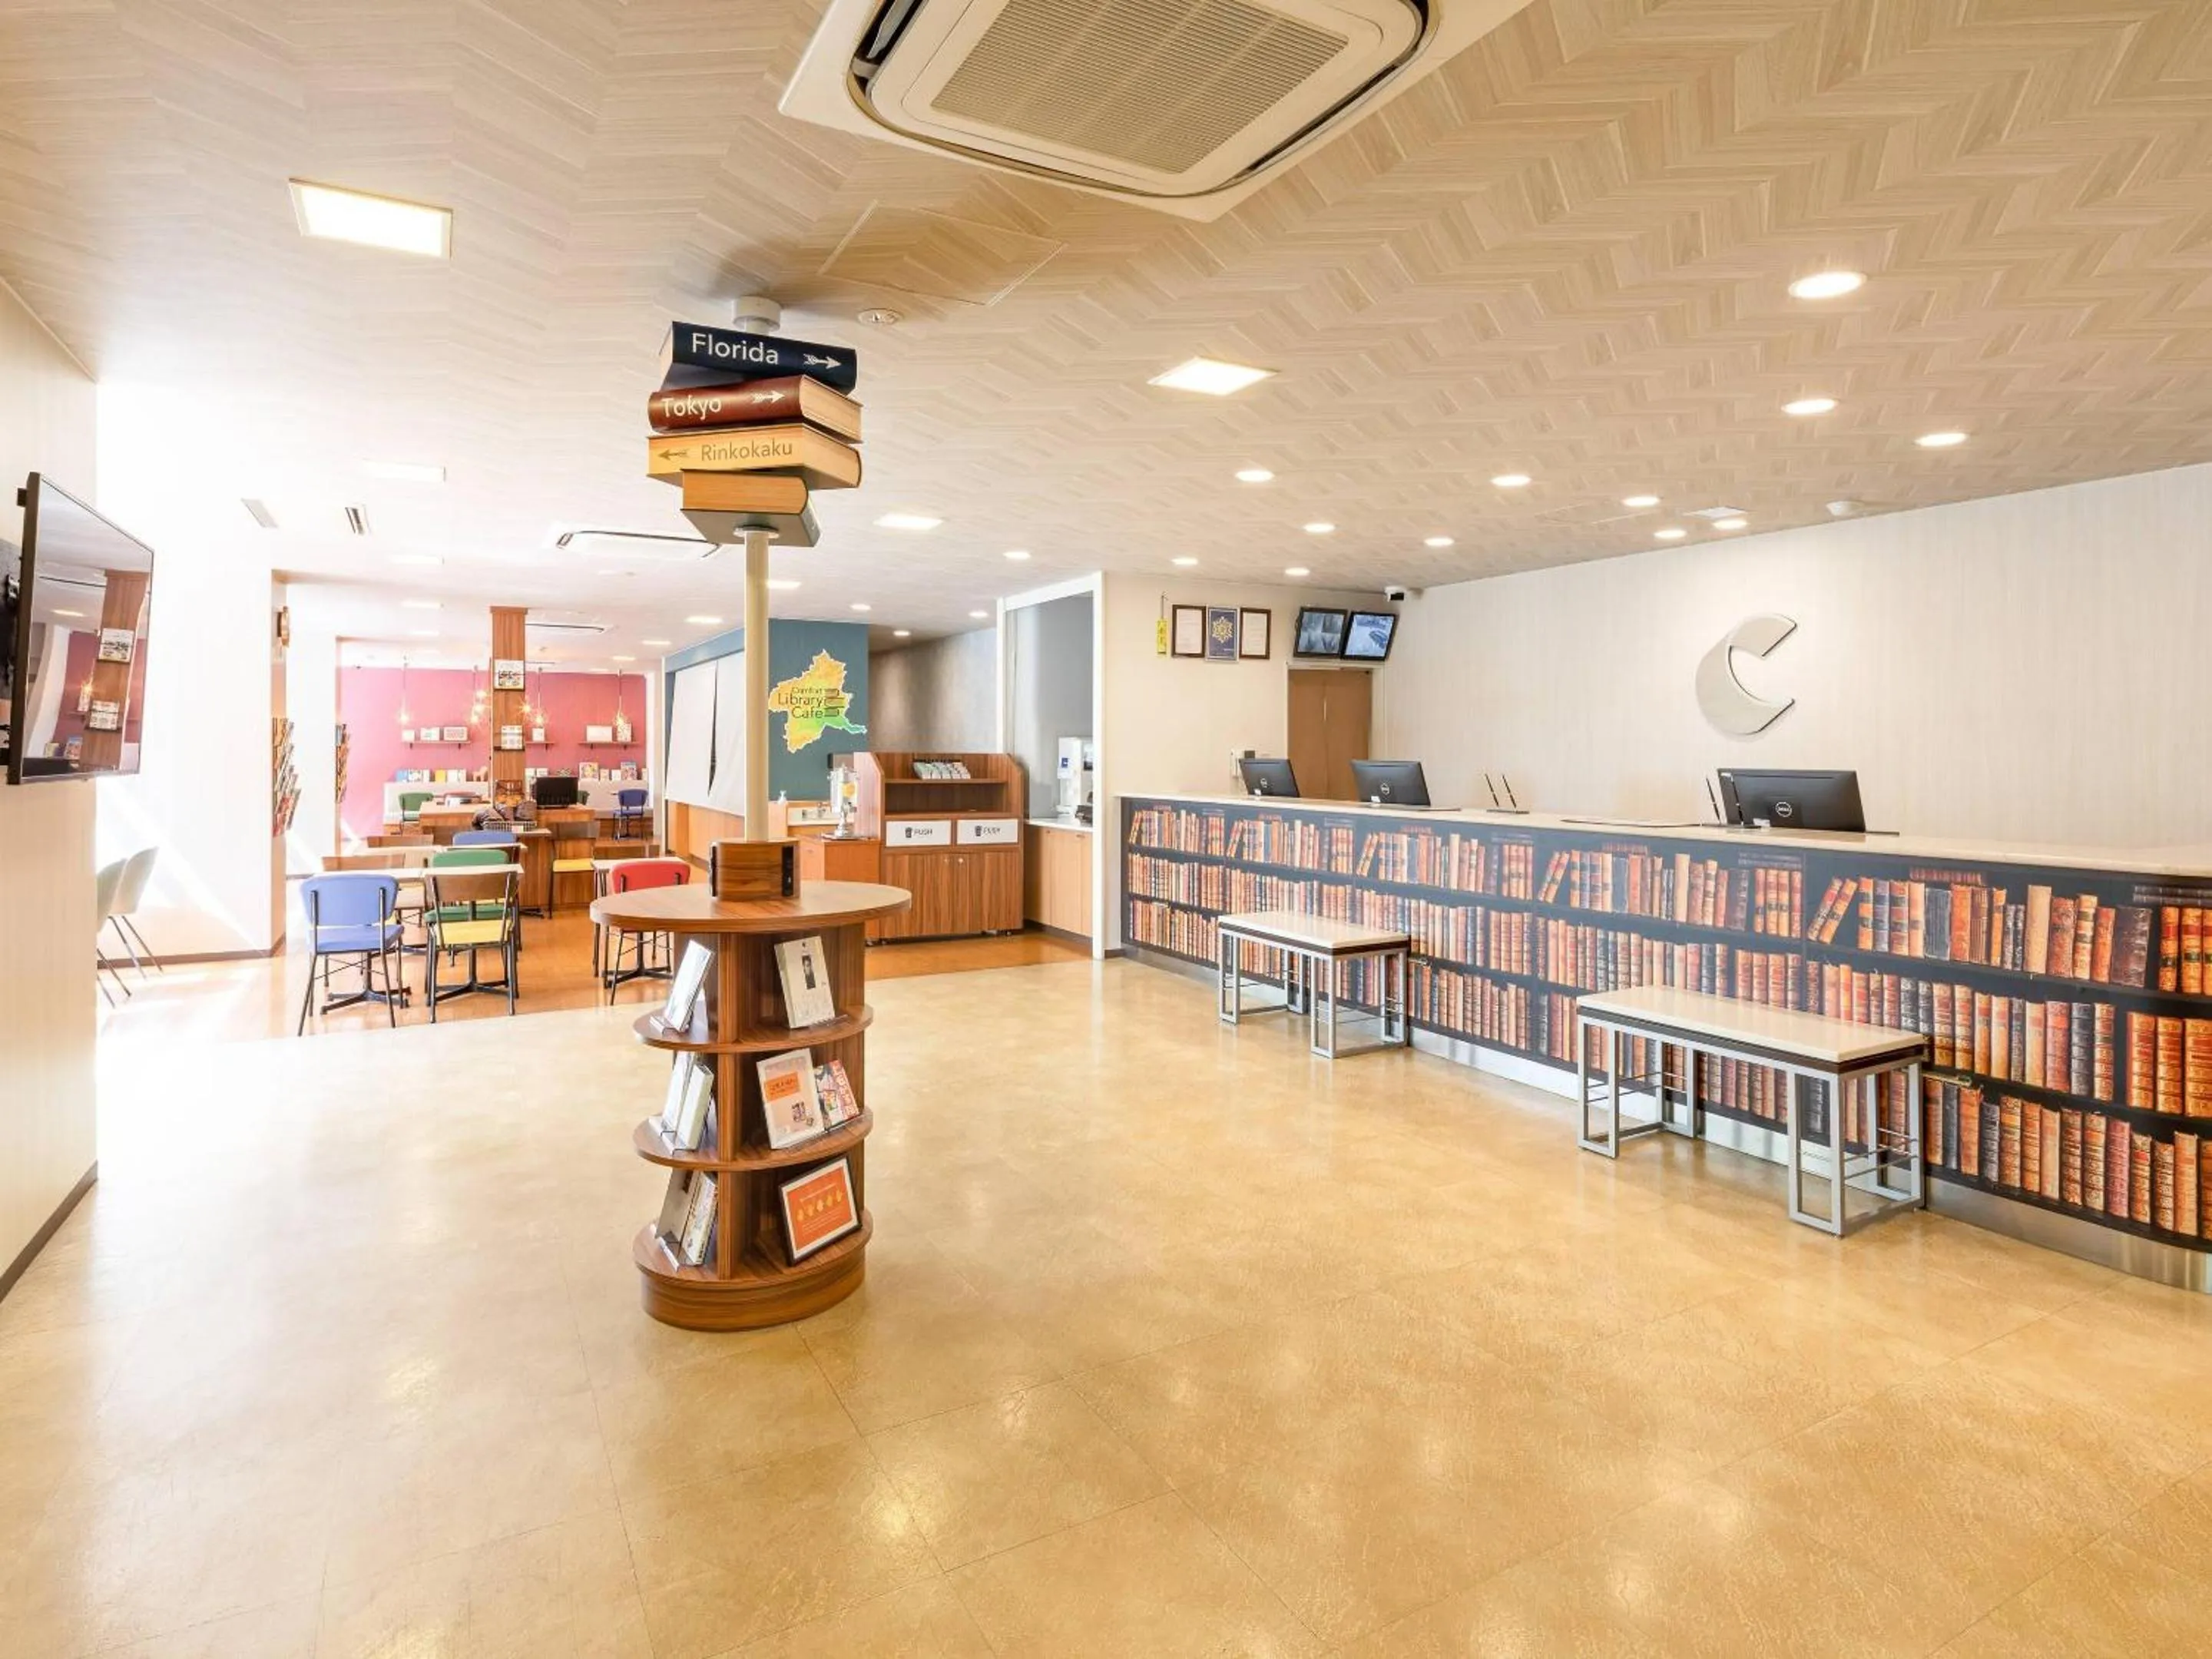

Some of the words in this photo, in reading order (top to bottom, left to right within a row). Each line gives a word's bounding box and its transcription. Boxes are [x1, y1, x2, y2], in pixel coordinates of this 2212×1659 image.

[691, 332, 779, 365] Florida
[661, 395, 722, 419] Tokyo
[700, 438, 793, 462] Rinkokaku
[777, 693, 823, 707] Library
